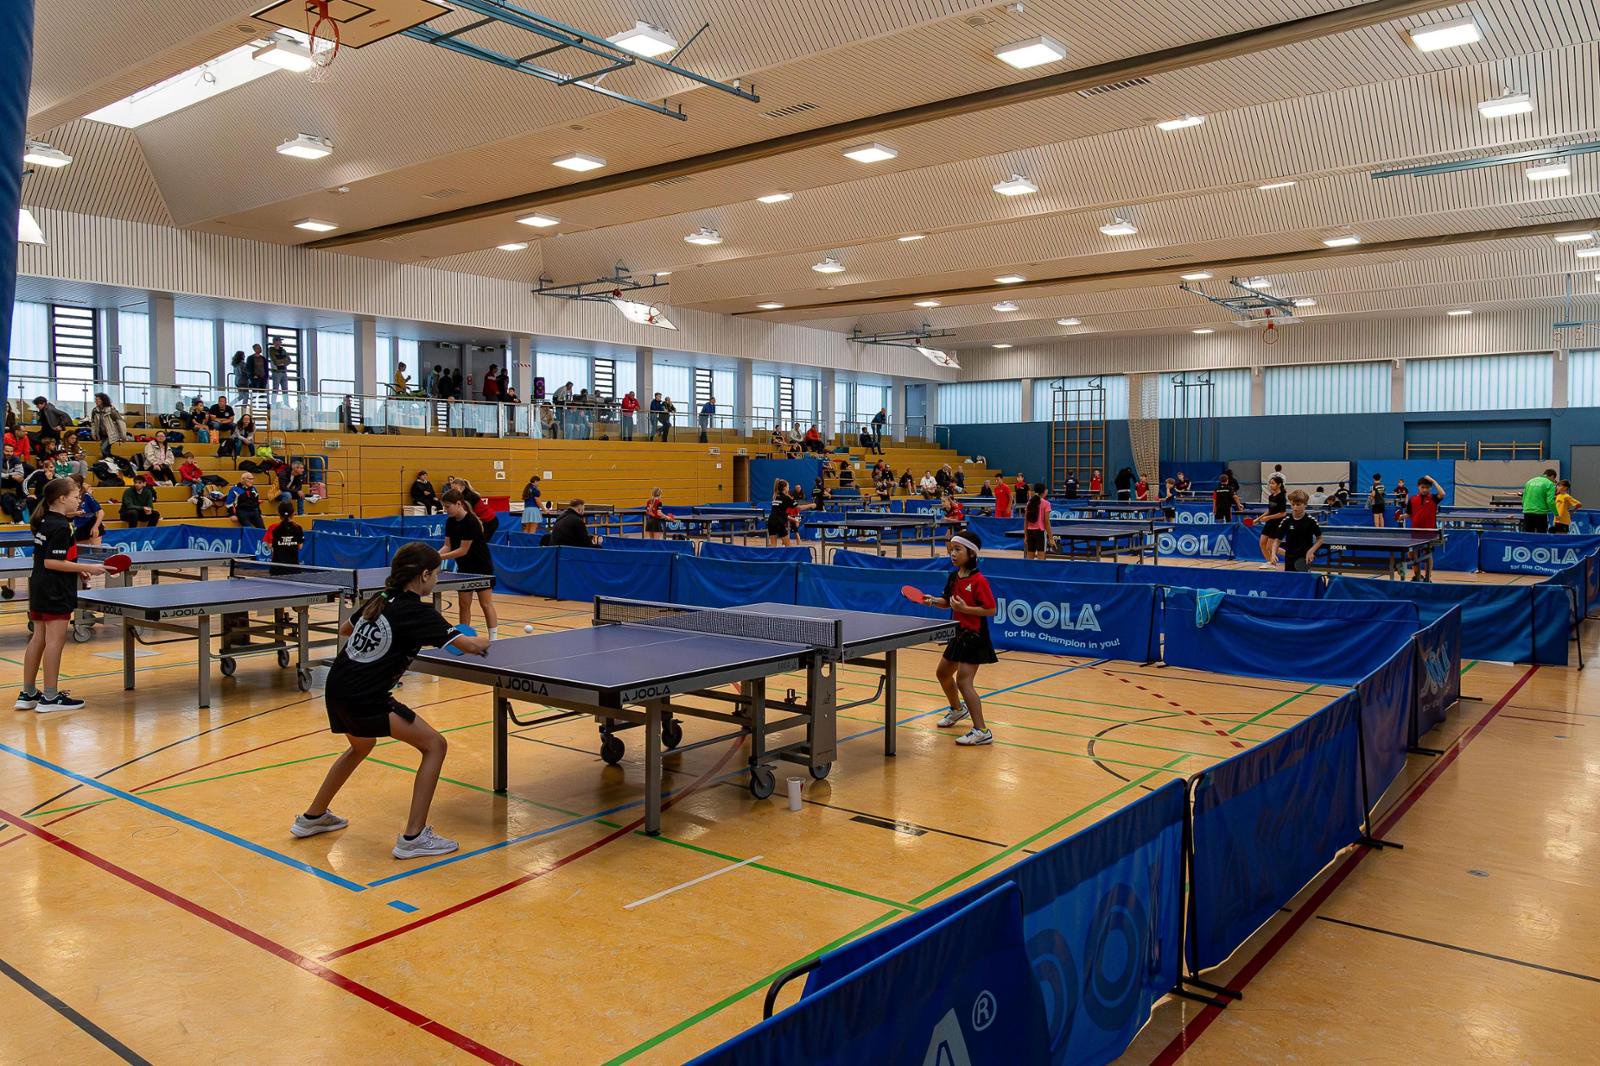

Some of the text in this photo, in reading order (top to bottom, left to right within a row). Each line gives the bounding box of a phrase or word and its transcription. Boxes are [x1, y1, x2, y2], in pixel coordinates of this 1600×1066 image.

[1502, 546, 1580, 565] JOOLA
[1534, 565, 1559, 574] Champ
[171, 608, 206, 617] JOOLA
[993, 597, 1102, 632] JOOLA
[934, 628, 955, 641] JOOLA
[1005, 630, 1018, 638] for
[1021, 630, 1036, 639] the
[1038, 632, 1086, 648] Champion
[1099, 638, 1120, 650] you!
[506, 676, 549, 696] JOOLA
[632, 685, 671, 700] JOOLA
